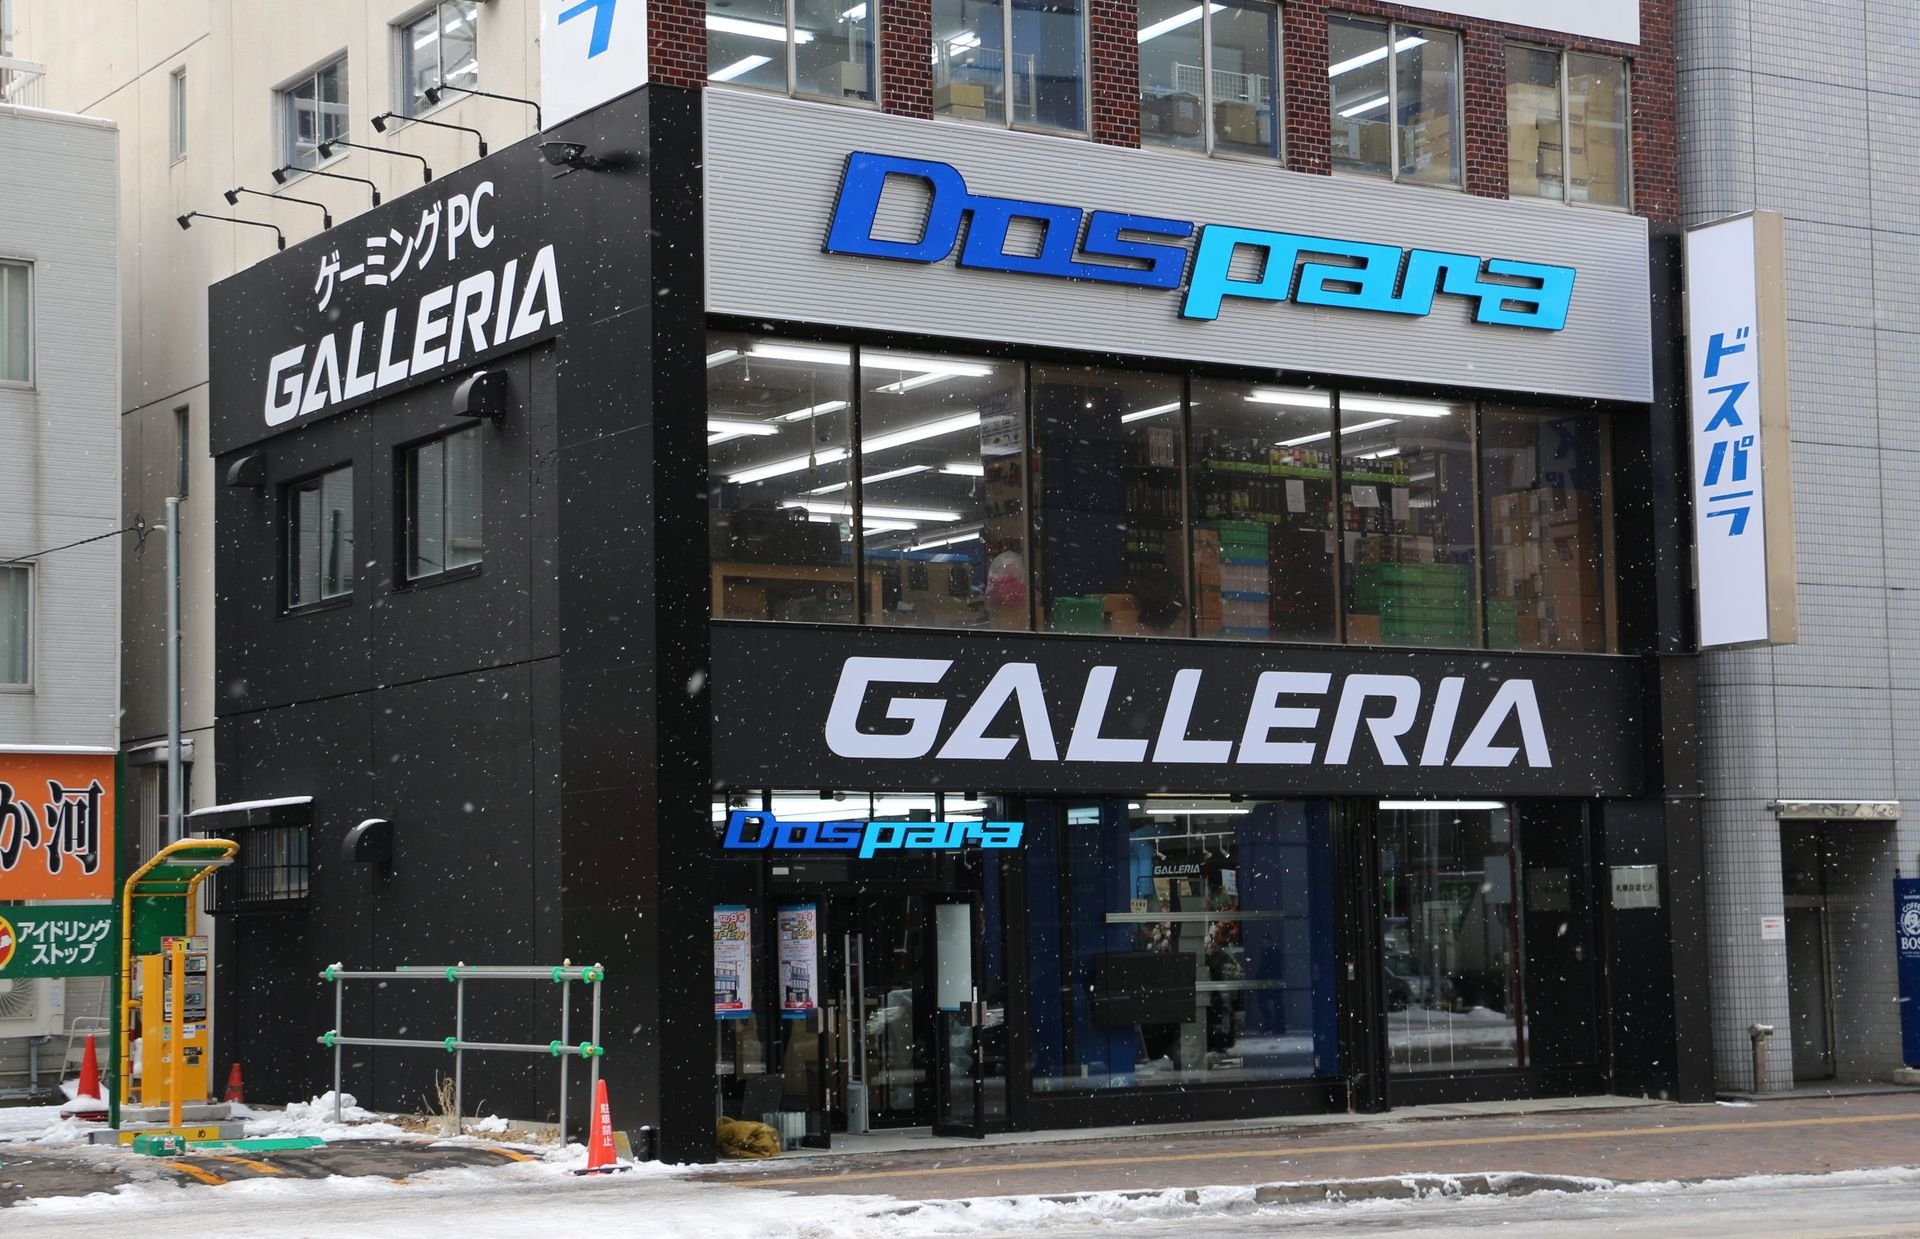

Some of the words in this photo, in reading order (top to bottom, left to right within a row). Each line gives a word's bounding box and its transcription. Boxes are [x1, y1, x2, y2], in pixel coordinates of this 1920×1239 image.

[314, 181, 495, 313] ゲーミングPC
[822, 151, 1576, 332] Dospara
[264, 244, 563, 427] GALLERIA
[1703, 325, 1754, 537] ドスパラ
[824, 656, 1552, 769] GALLERIA
[722, 810, 1025, 859] Dospara
[1154, 863, 1201, 875] GALLERIA
[17, 919, 112, 943] アイドリング
[32, 942, 97, 965] ストップ
[600, 1103, 613, 1147] 駐車禁止
